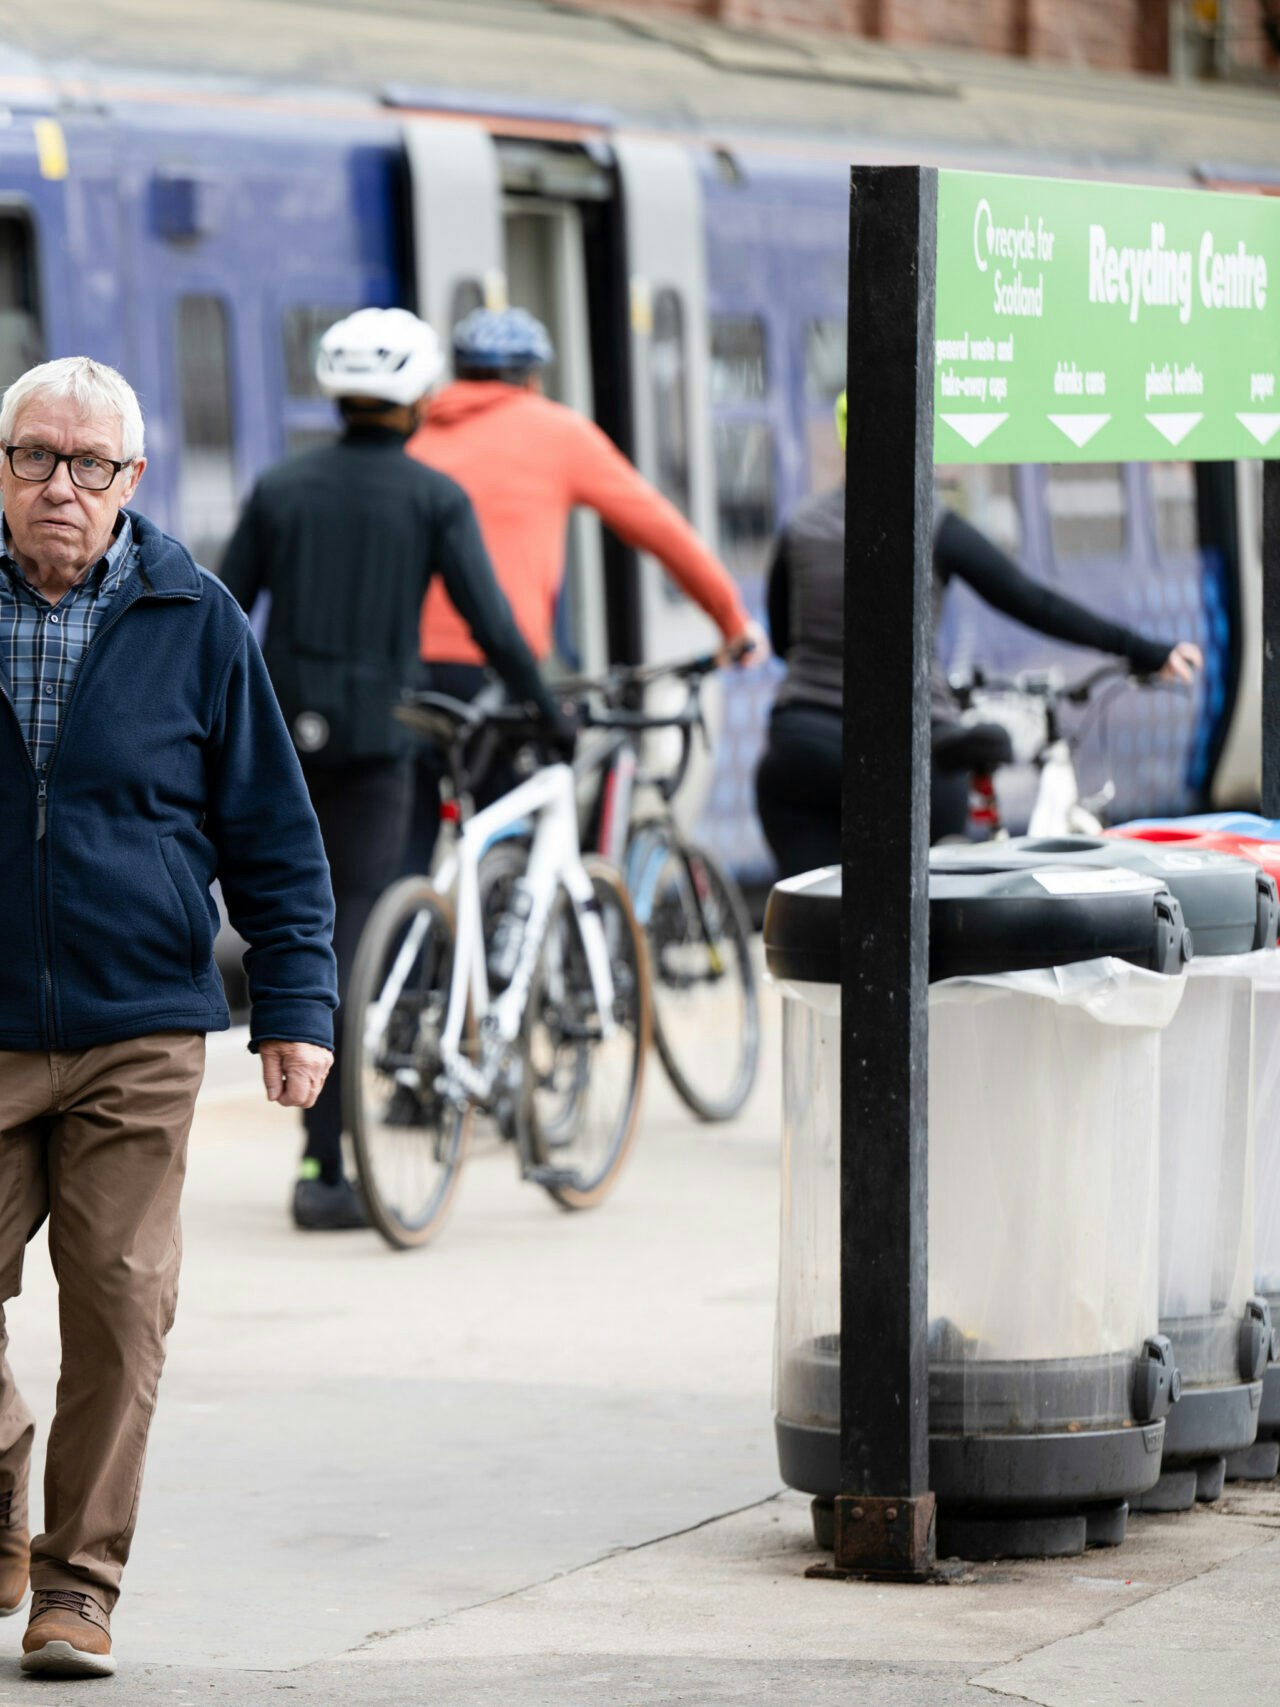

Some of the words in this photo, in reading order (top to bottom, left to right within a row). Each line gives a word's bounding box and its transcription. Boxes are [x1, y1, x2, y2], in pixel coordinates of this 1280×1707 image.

[995, 215, 1034, 268] recycle
[1037, 216, 1054, 261] for
[994, 269, 1043, 317] Scotland
[1089, 222, 1192, 324] Recycling
[1199, 230, 1267, 310] Centre
[1054, 361, 1083, 394] drinks
[1174, 362, 1203, 395] bottles
